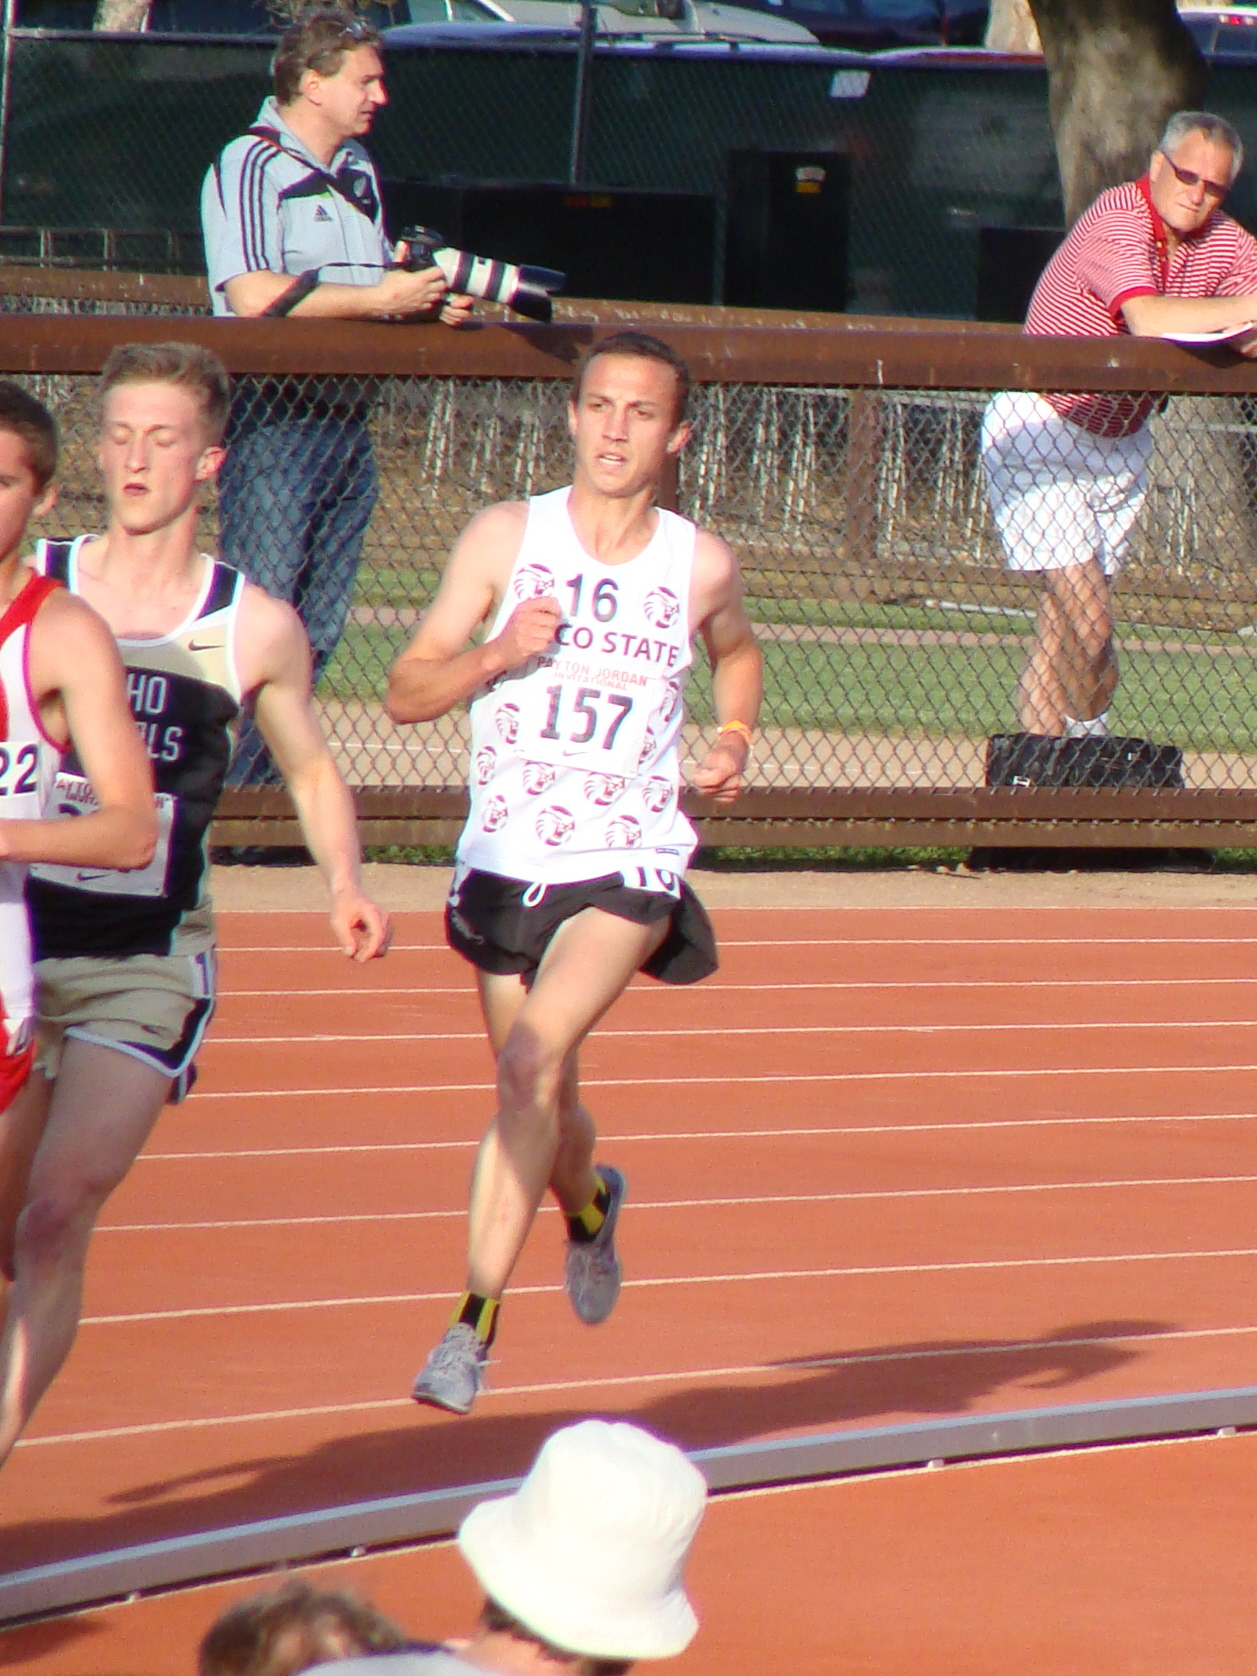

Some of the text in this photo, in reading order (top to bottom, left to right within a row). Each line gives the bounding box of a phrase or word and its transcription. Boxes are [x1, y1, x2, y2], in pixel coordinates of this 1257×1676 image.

[566, 573, 619, 623] 16
[601, 632, 680, 668] STATE
[537, 656, 648, 687] PAYTON JORDAN
[554, 671, 628, 691] INVITATIONAL
[540, 684, 633, 750] 157
